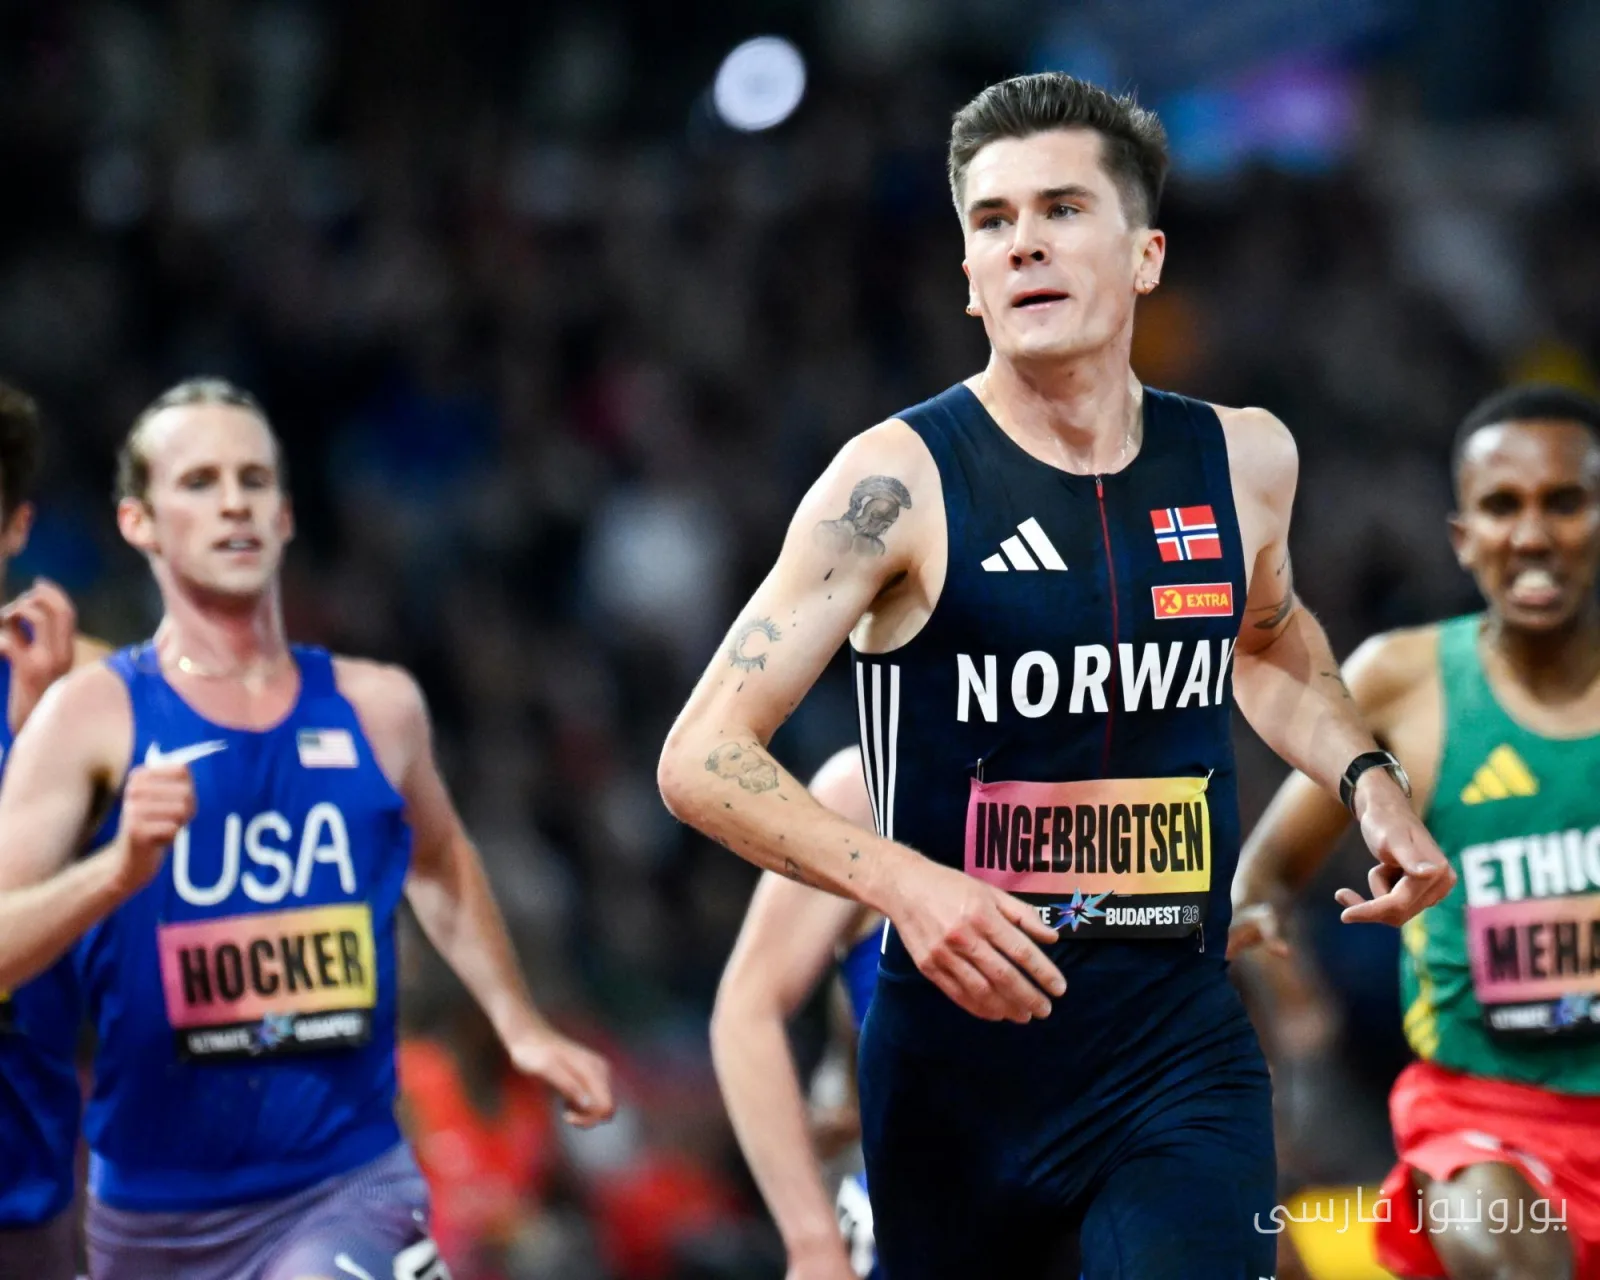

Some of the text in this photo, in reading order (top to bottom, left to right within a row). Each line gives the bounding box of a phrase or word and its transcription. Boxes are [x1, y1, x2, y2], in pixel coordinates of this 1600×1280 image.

[1186, 593, 1229, 608] EXTRA
[956, 637, 1236, 723] NORWAY
[173, 802, 356, 906] USA
[975, 801, 1204, 875] INGEBRIGTSEN
[1105, 905, 1199, 926] BUDAPEST 26
[178, 930, 364, 1008] HOCKER
